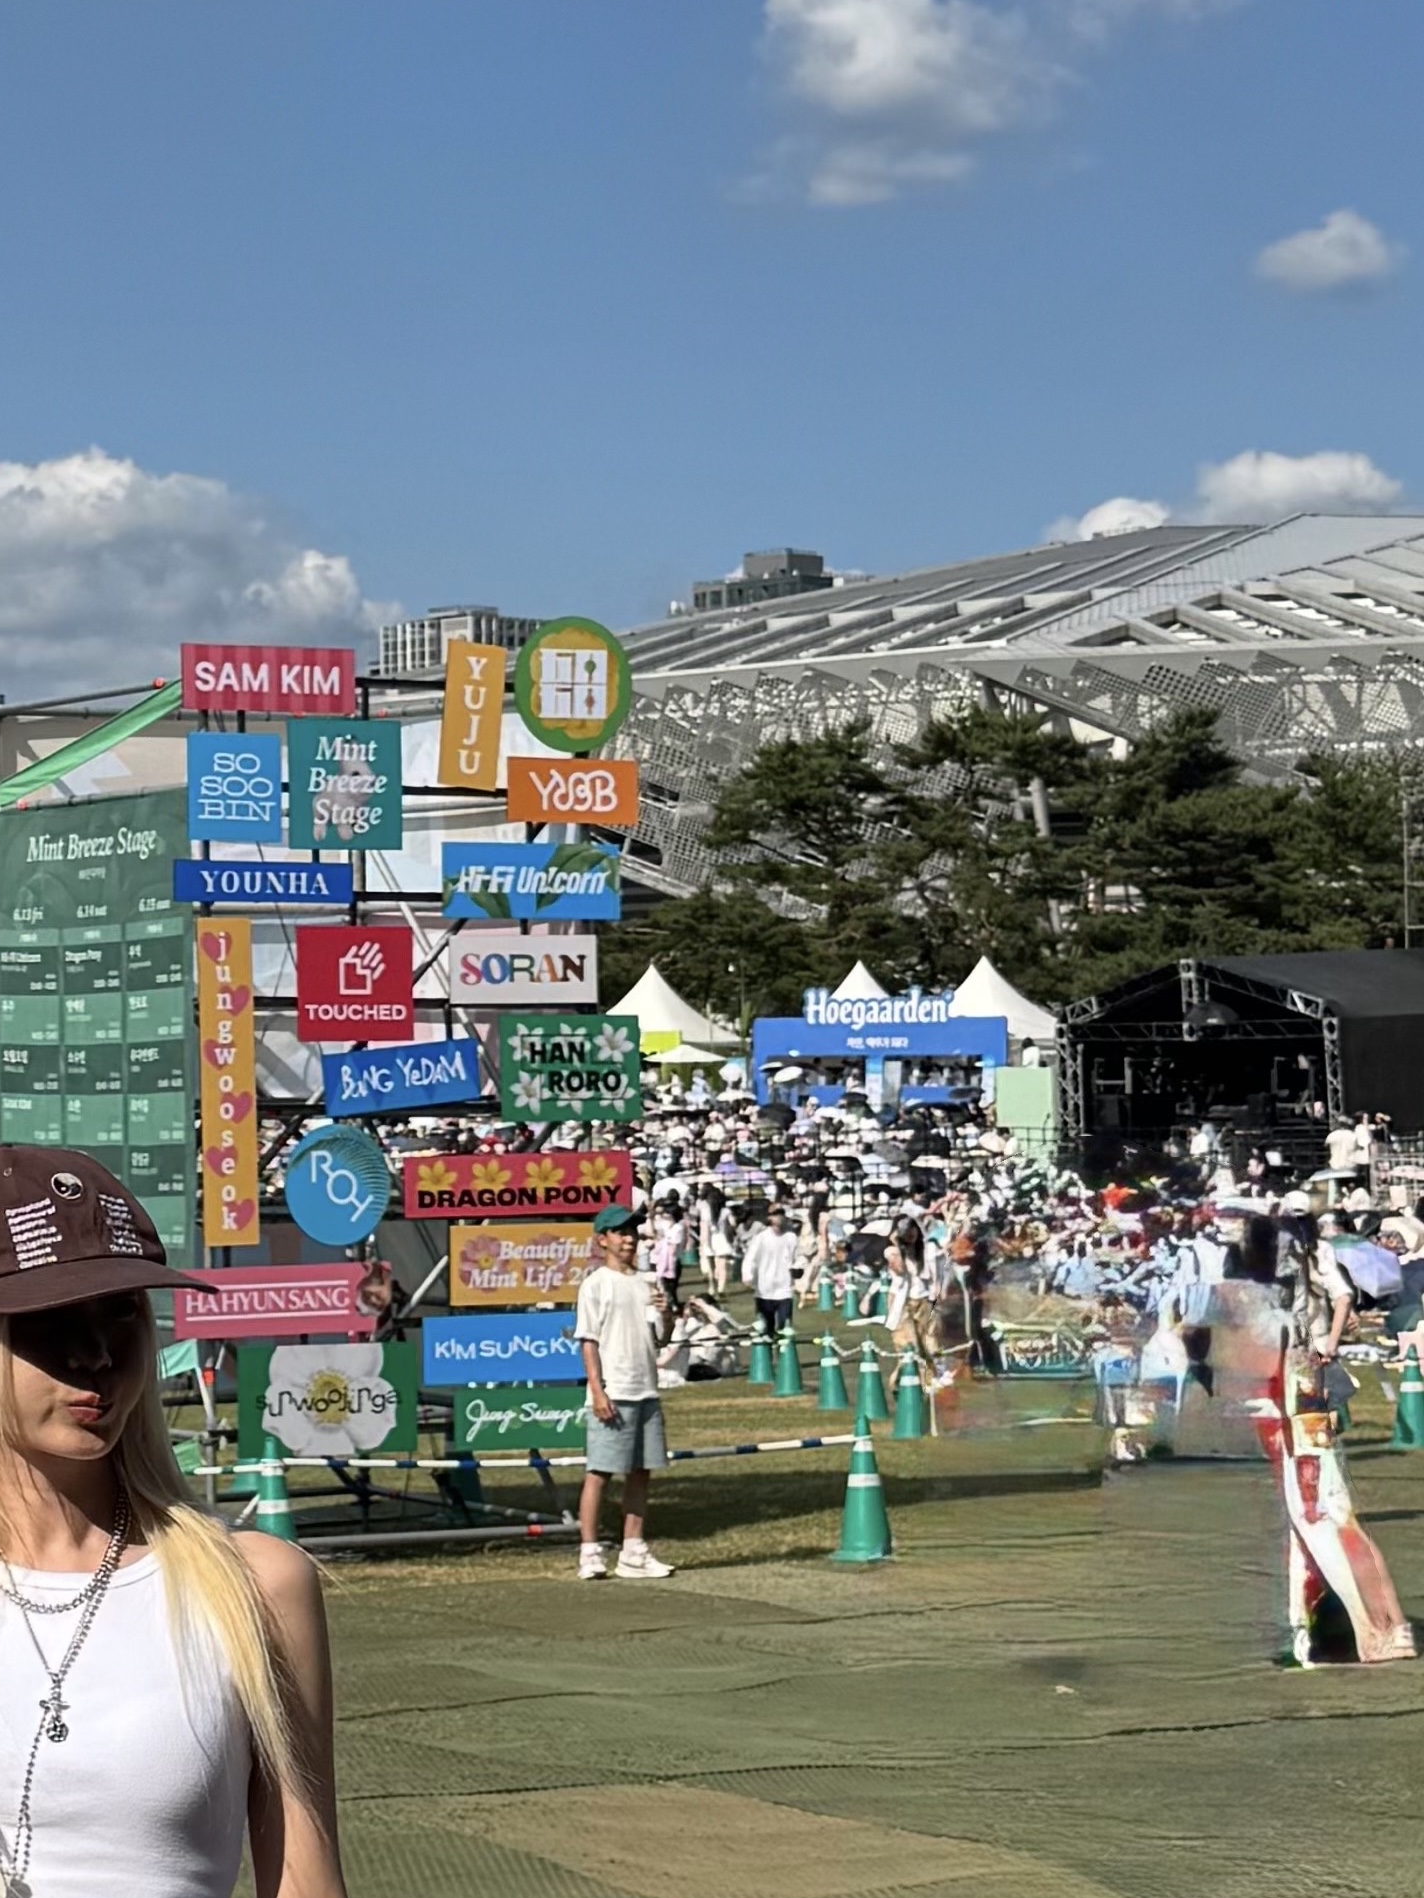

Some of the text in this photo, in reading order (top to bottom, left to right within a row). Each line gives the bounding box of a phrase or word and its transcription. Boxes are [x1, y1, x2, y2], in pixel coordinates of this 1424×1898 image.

[194, 661, 341, 696] SAM KIM
[458, 656, 489, 775] YUJU
[315, 734, 378, 762] Mint
[213, 752, 261, 775] SO
[200, 776, 273, 798] SOO
[307, 767, 388, 794] Breeze
[197, 798, 276, 822] BIN
[313, 799, 383, 832] Stage
[26, 827, 156, 862] Mint Breeze Stage
[199, 870, 330, 895] YOUNHA
[451, 865, 517, 894] Hi-Fi
[459, 953, 587, 986] SORAN
[304, 1004, 407, 1021] TOUCHED
[805, 986, 948, 1030] Hoegaarden
[529, 1041, 587, 1064] HAN
[214, 932, 240, 1230] jungwooseok
[548, 1070, 622, 1094] RORO
[310, 1150, 375, 1222] ROY
[417, 1184, 622, 1209] DRAGON PONY
[499, 1237, 593, 1264] Beautiful
[468, 1268, 518, 1290] Mint
[525, 1267, 564, 1293] Life
[185, 1287, 350, 1315] HA HYUN SANG
[434, 1335, 581, 1361] KIM SUNG KY
[255, 1386, 402, 1417] sunwoojunga
[465, 1398, 517, 1442] Jung
